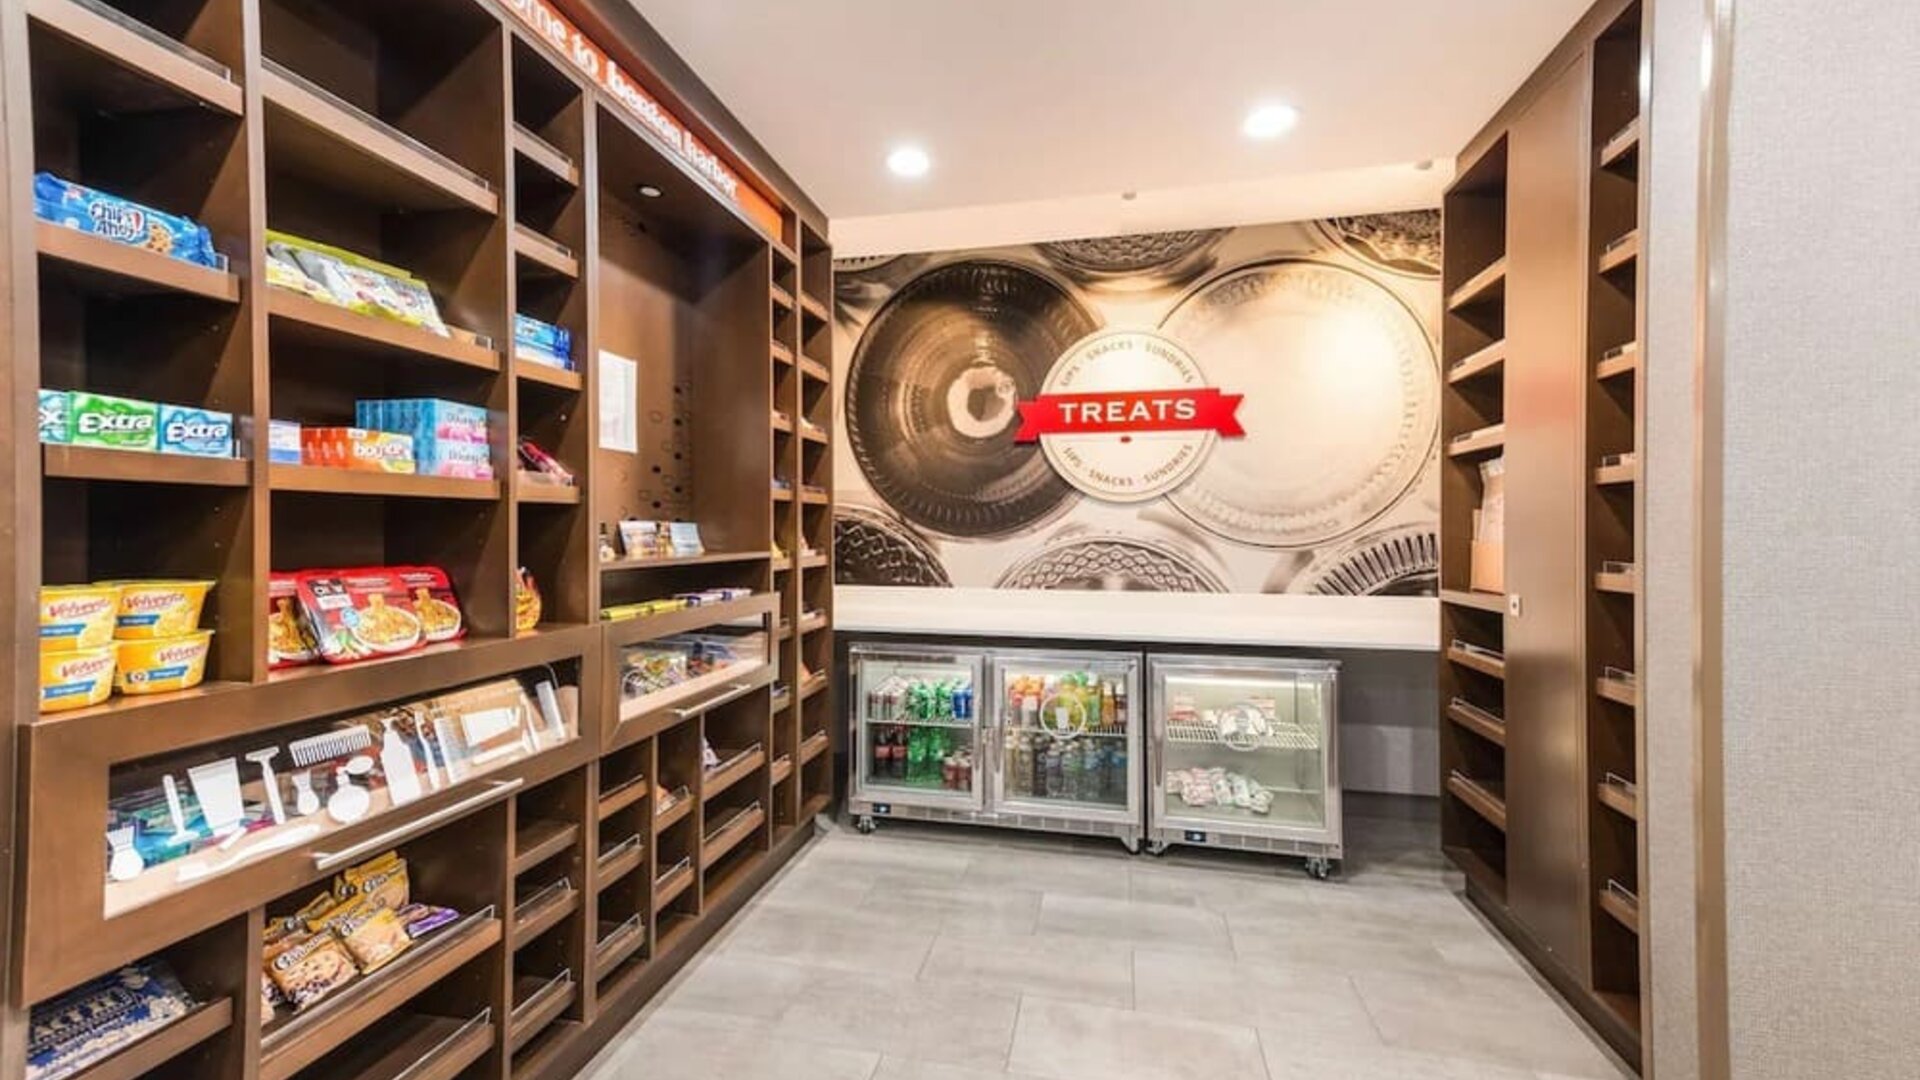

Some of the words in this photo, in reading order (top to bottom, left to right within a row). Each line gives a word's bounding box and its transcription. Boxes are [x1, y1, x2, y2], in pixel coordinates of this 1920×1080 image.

[571, 32, 599, 76] to
[1085, 340, 1134, 362] SNACKS
[1145, 342, 1195, 384] SUNDRIES
[78, 412, 153, 434] Extra
[1057, 398, 1197, 425] TREATS
[166, 421, 228, 443] Extra
[1062, 446, 1083, 469] SIPS
[1089, 468, 1134, 487] SNACKS
[1143, 443, 1194, 483] SUNDRIES
